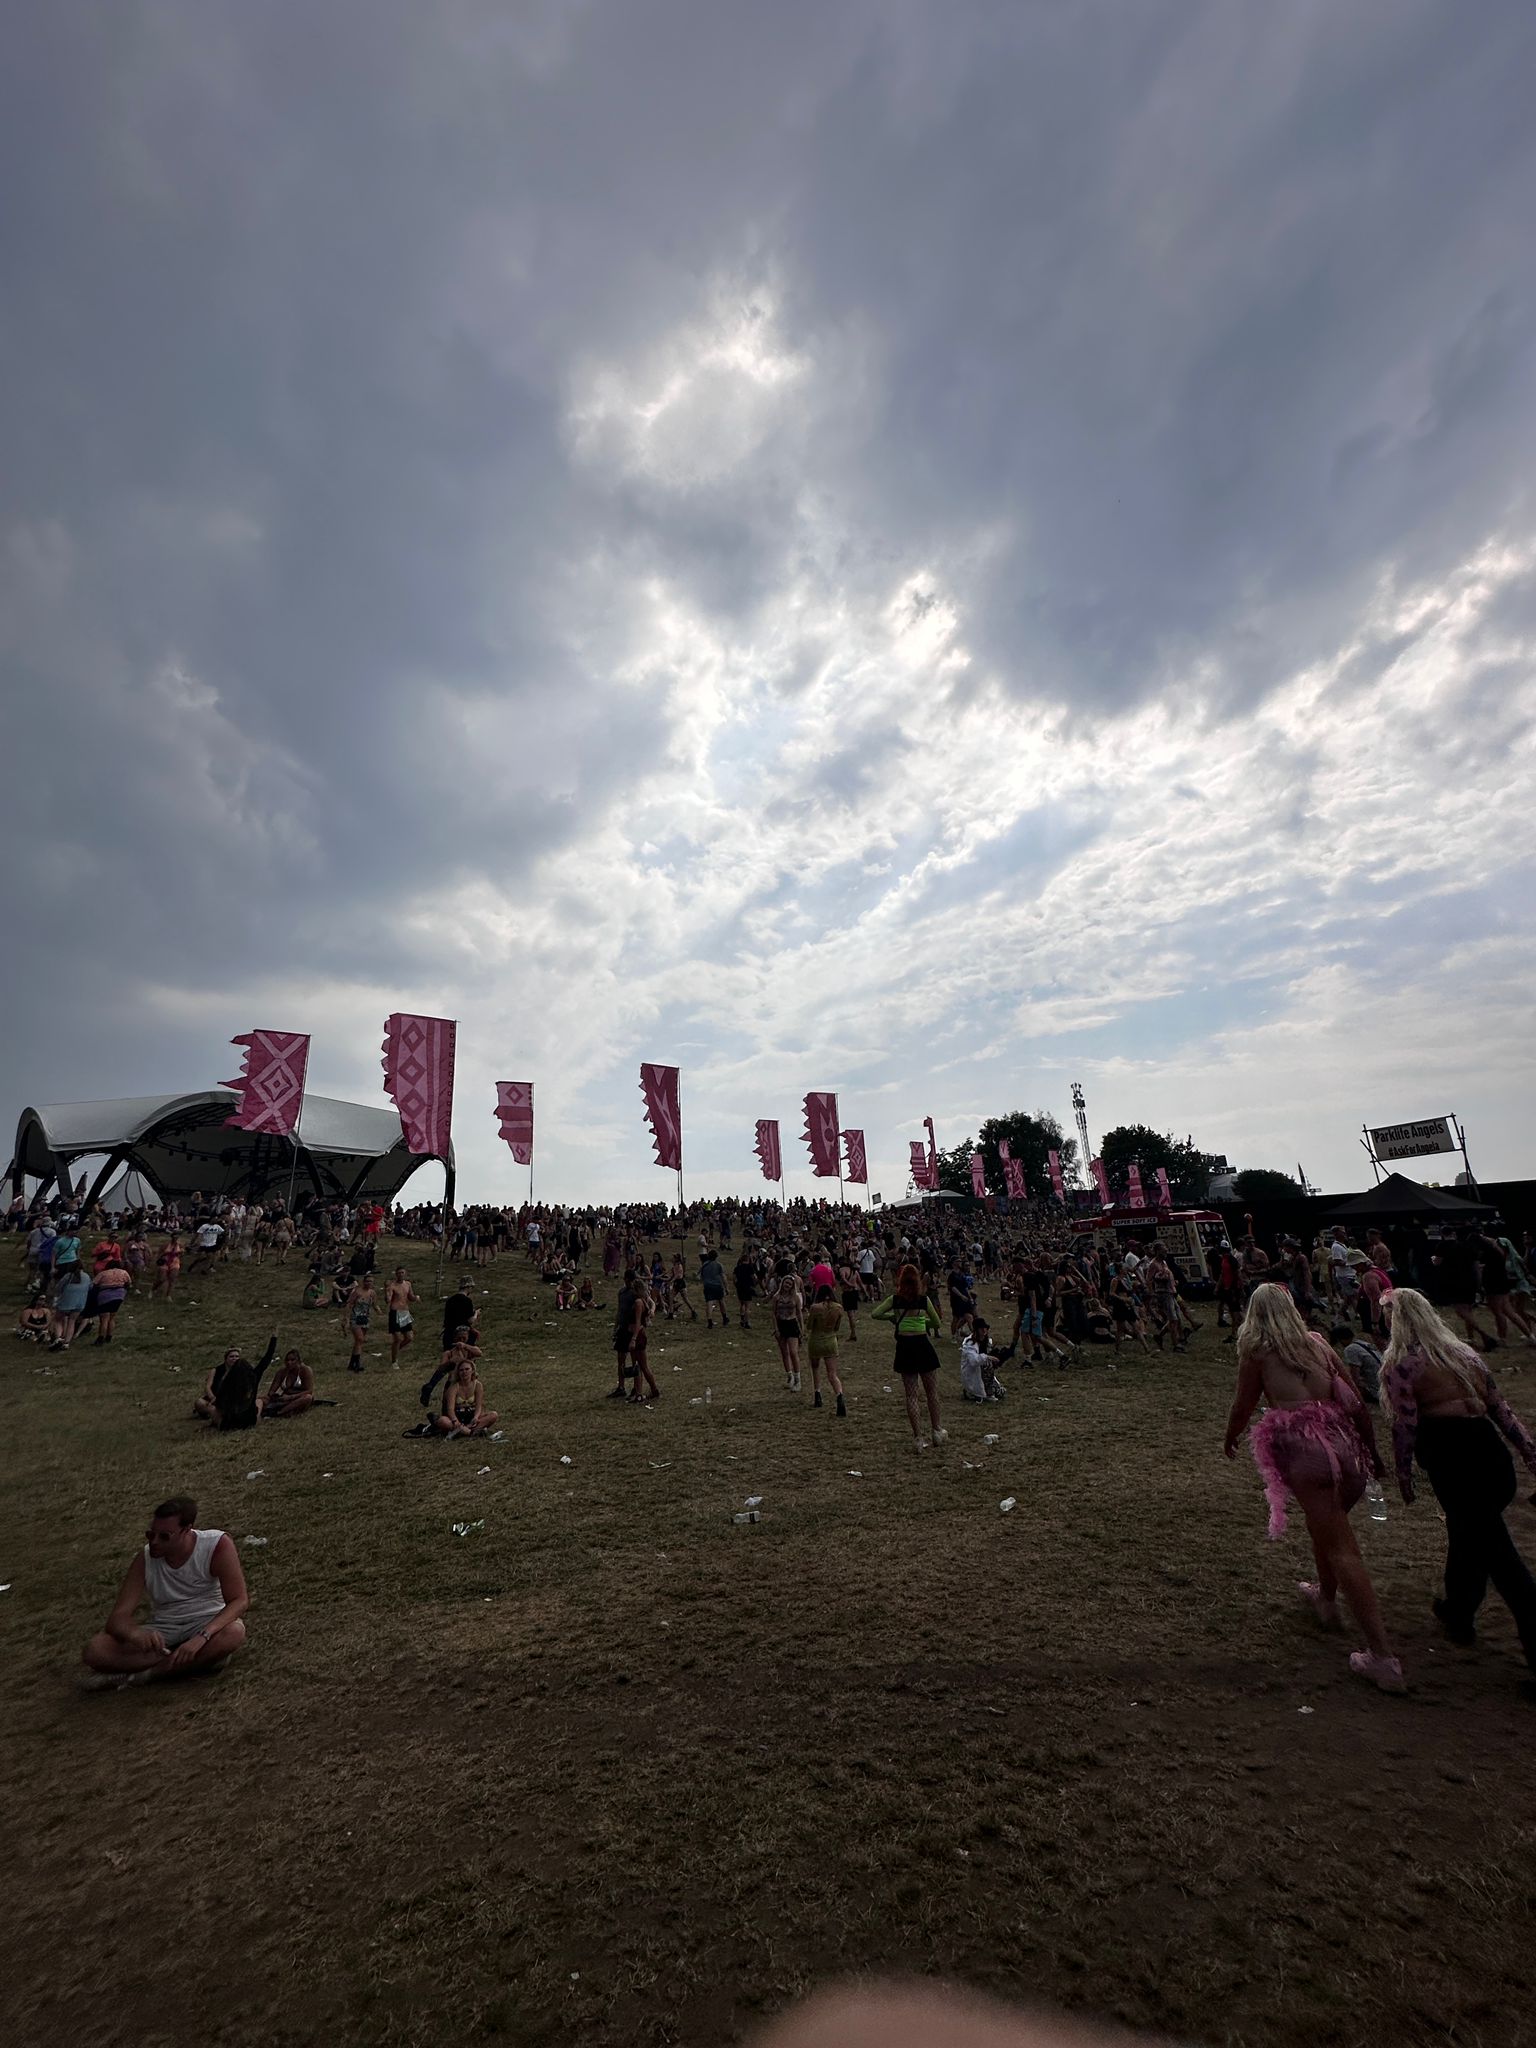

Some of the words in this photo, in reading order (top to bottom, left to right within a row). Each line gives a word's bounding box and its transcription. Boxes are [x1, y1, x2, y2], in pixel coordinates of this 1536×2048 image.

[1374, 1127, 1410, 1143] Parklife
[1411, 1122, 1444, 1138] Angels
[1388, 1141, 1440, 1157] #AskForAngela
